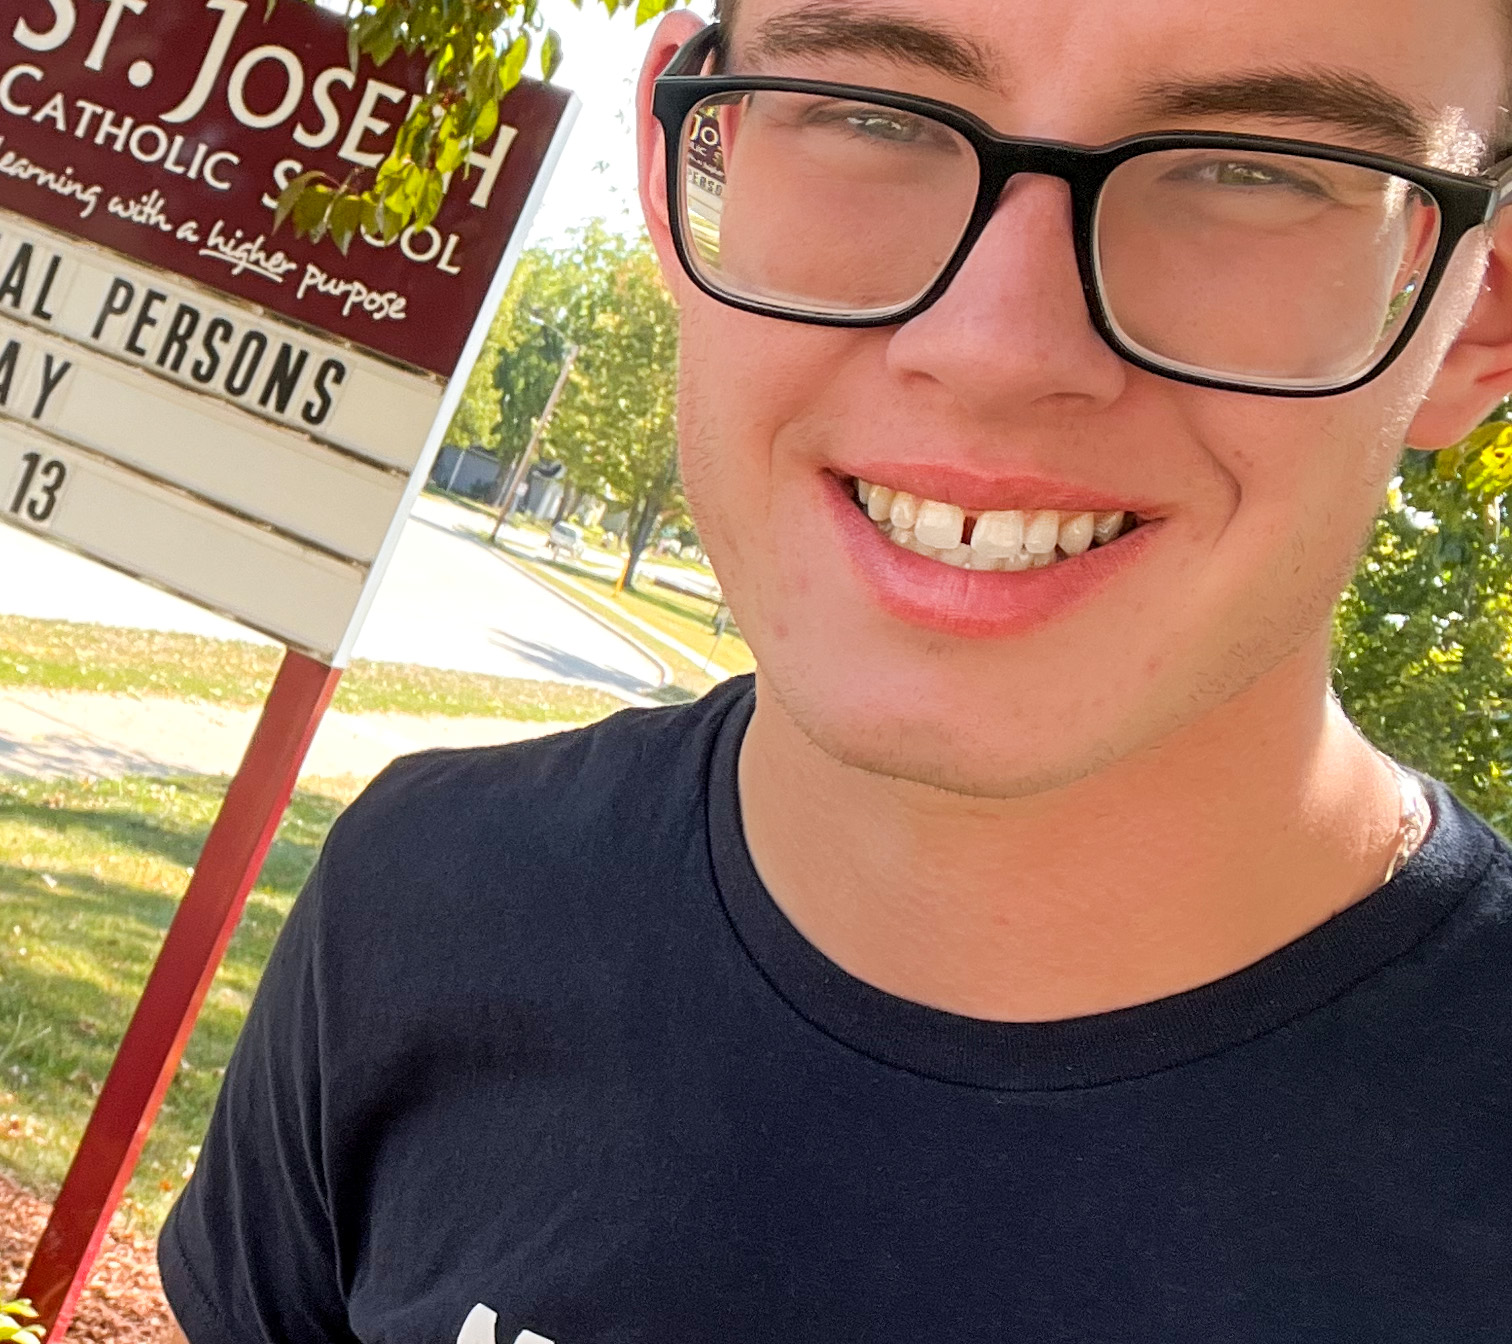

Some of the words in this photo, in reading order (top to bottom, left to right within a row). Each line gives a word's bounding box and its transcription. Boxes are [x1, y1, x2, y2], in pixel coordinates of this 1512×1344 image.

[108, 189, 172, 232] with
[176, 221, 200, 242] a
[203, 220, 297, 276] higher
[297, 263, 407, 321] purpose
[92, 277, 346, 426] PERSONS
[10, 452, 67, 523] 13
